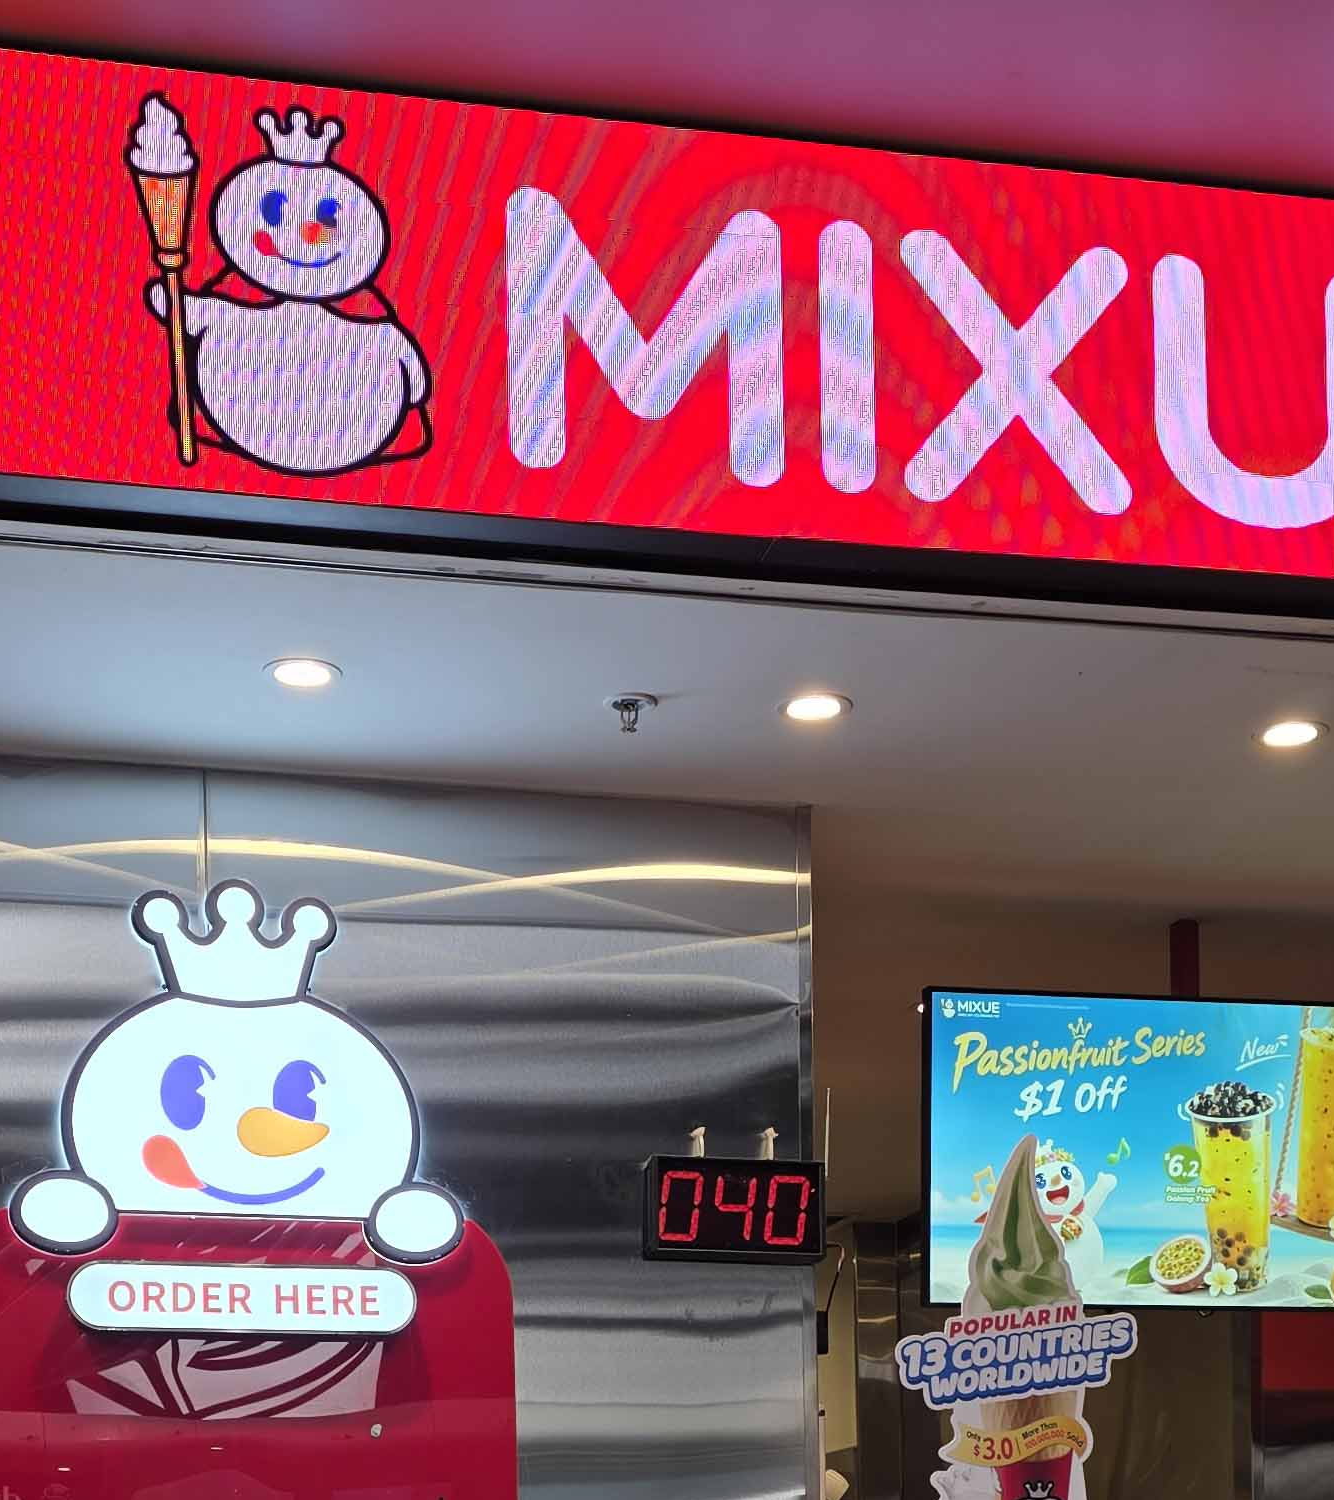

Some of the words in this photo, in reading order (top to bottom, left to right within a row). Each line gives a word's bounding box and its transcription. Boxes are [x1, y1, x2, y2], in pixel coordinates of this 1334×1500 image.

[957, 999, 1001, 1014] MIXUE
[953, 1031, 1130, 1094] Passionfruit
[1131, 1026, 1207, 1065] Series
[1239, 1038, 1280, 1065] New
[1013, 1079, 1065, 1122] $1
[1074, 1075, 1129, 1113] Off
[658, 1170, 811, 1246] 040
[107, 1280, 253, 1315] ORDER
[275, 1283, 381, 1317] HERE
[949, 1309, 1051, 1338] POPULAR
[1055, 1305, 1077, 1323] IN
[903, 1339, 947, 1378] 13
[952, 1319, 1131, 1370] COUNTRIES
[930, 1351, 1105, 1399] WORLDWIDE
[1021, 1427, 1040, 1438] More
